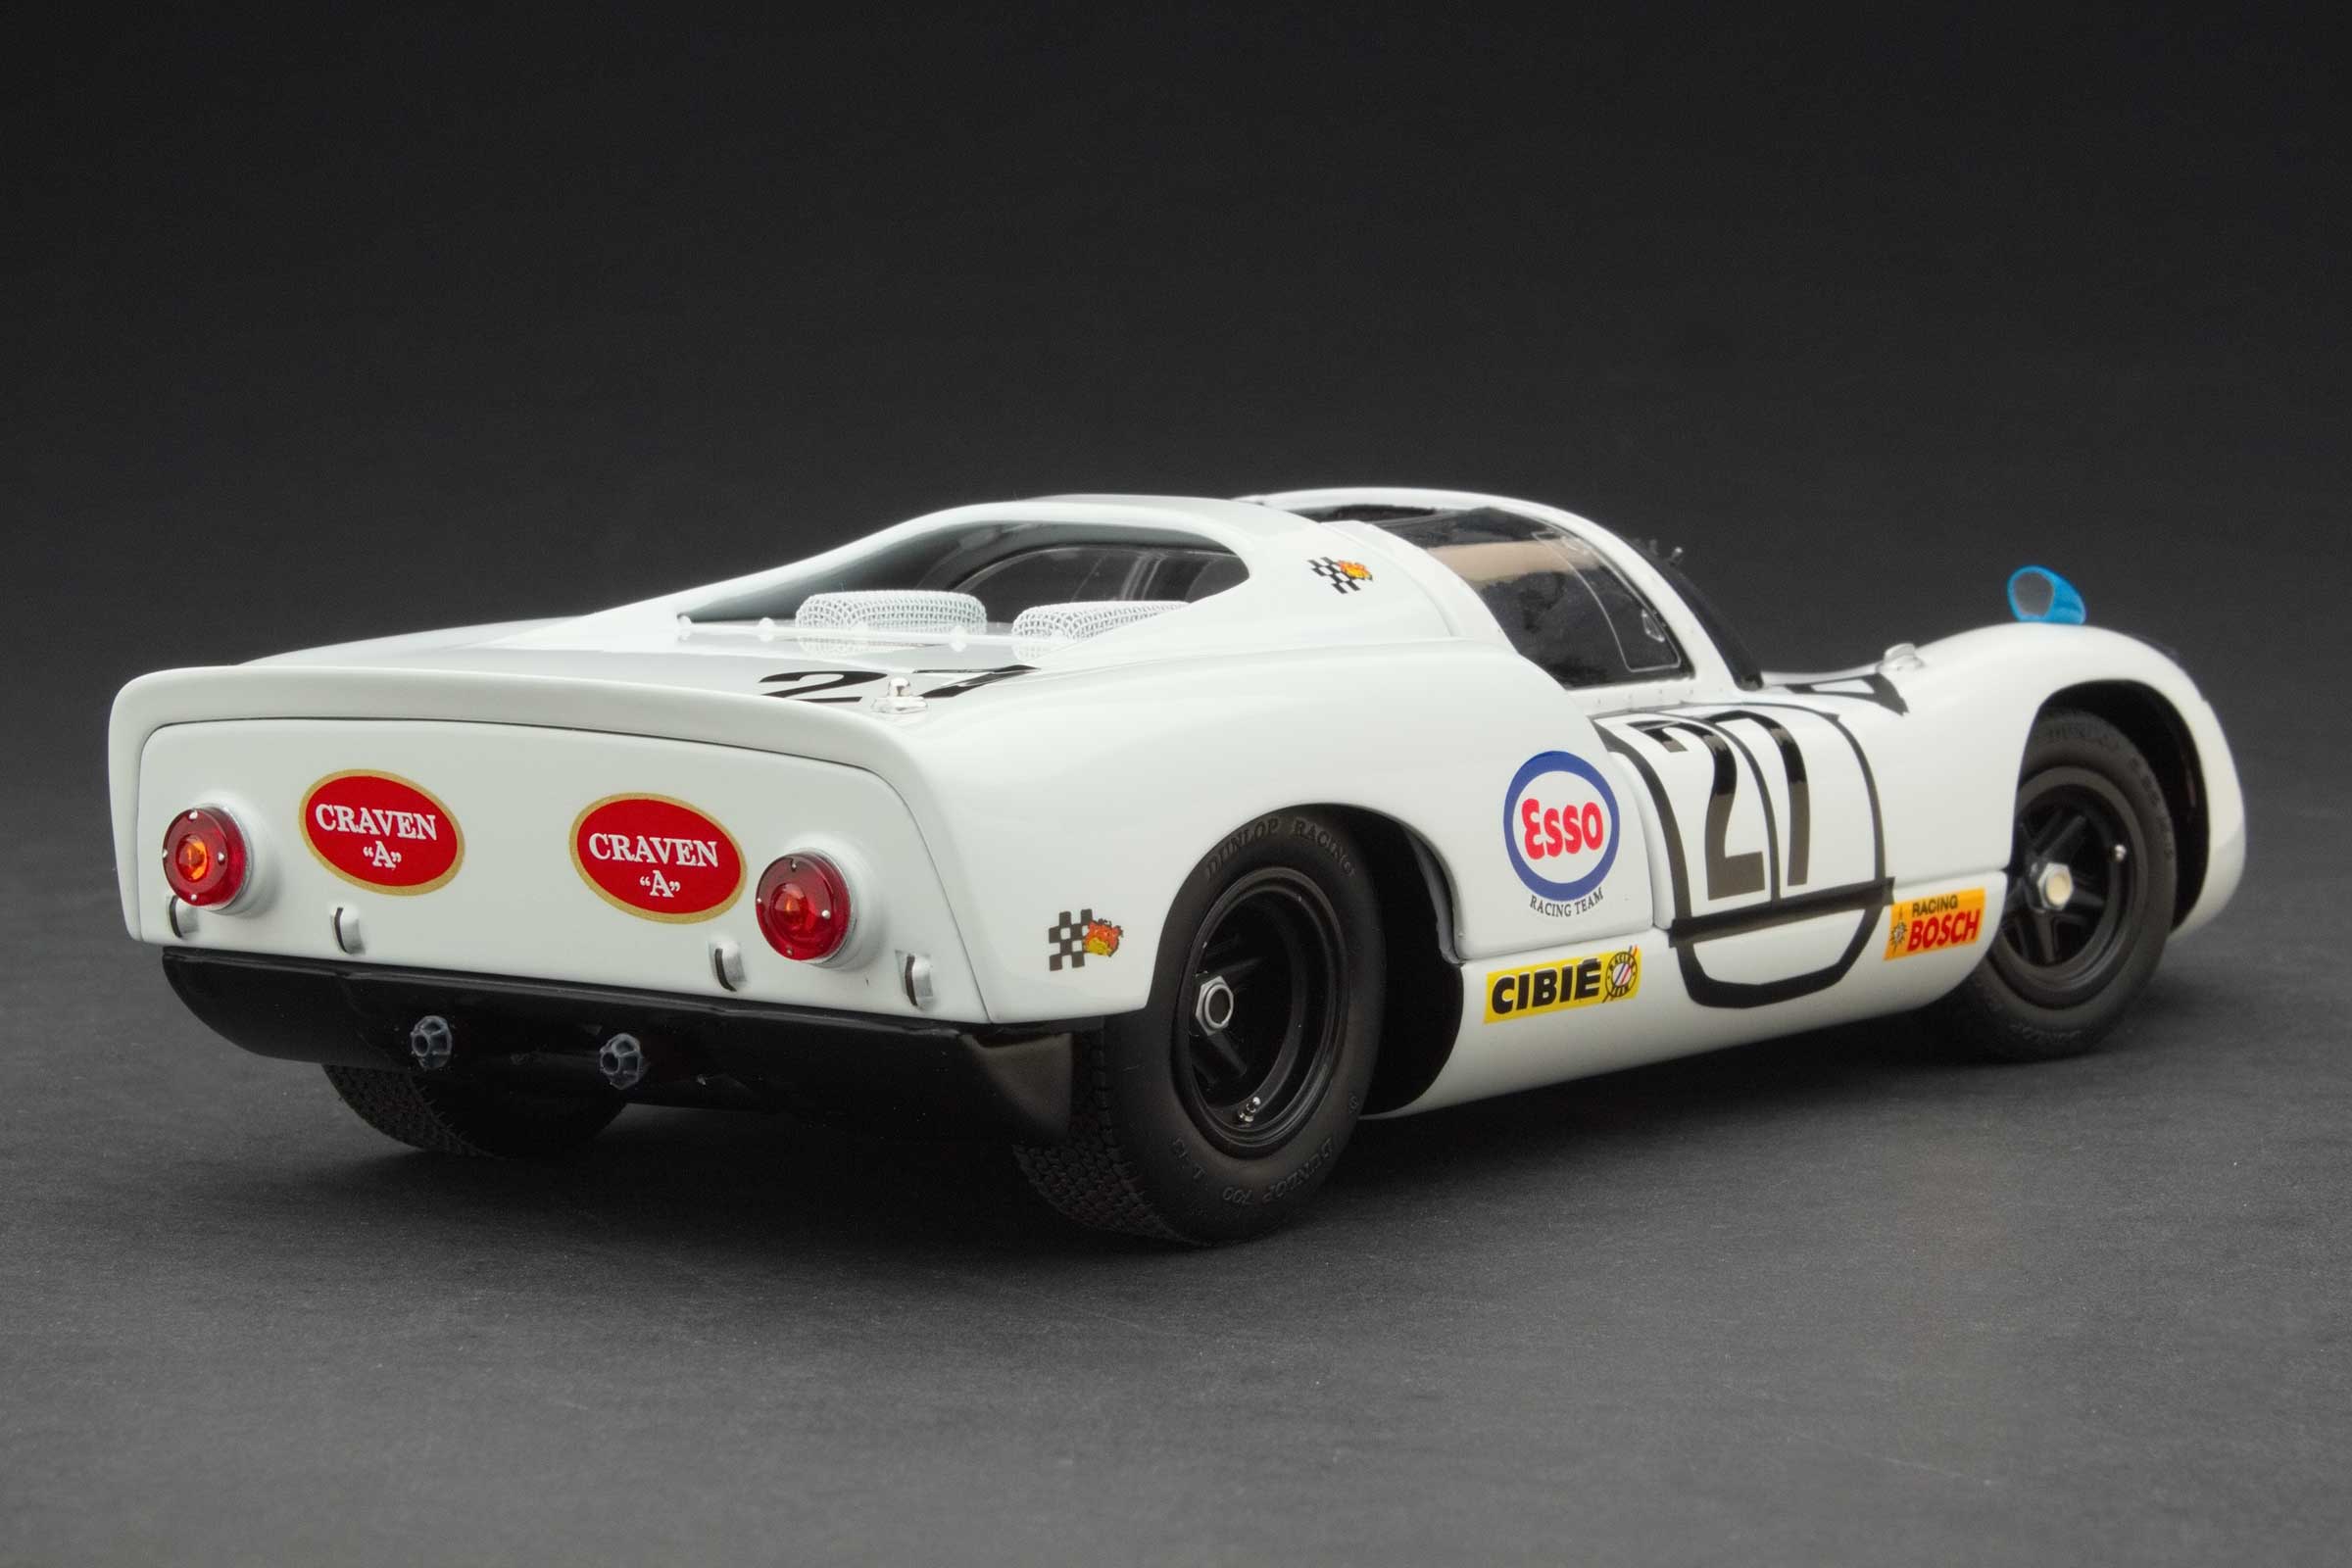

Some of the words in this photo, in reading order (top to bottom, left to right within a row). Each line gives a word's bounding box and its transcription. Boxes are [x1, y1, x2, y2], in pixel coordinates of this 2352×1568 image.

[759, 664, 1041, 703] 27
[315, 804, 438, 841] CRAVEN
[1626, 710, 1811, 901] 27
[589, 832, 719, 867] CRAVEN
[1206, 817, 1280, 880] DUNLOP
[1294, 820, 1356, 876] RACING
[1529, 895, 1572, 917] RACING
[1574, 887, 1604, 915] TEAM
[1912, 895, 1958, 917] RACING
[1906, 908, 1981, 952] BOSCH
